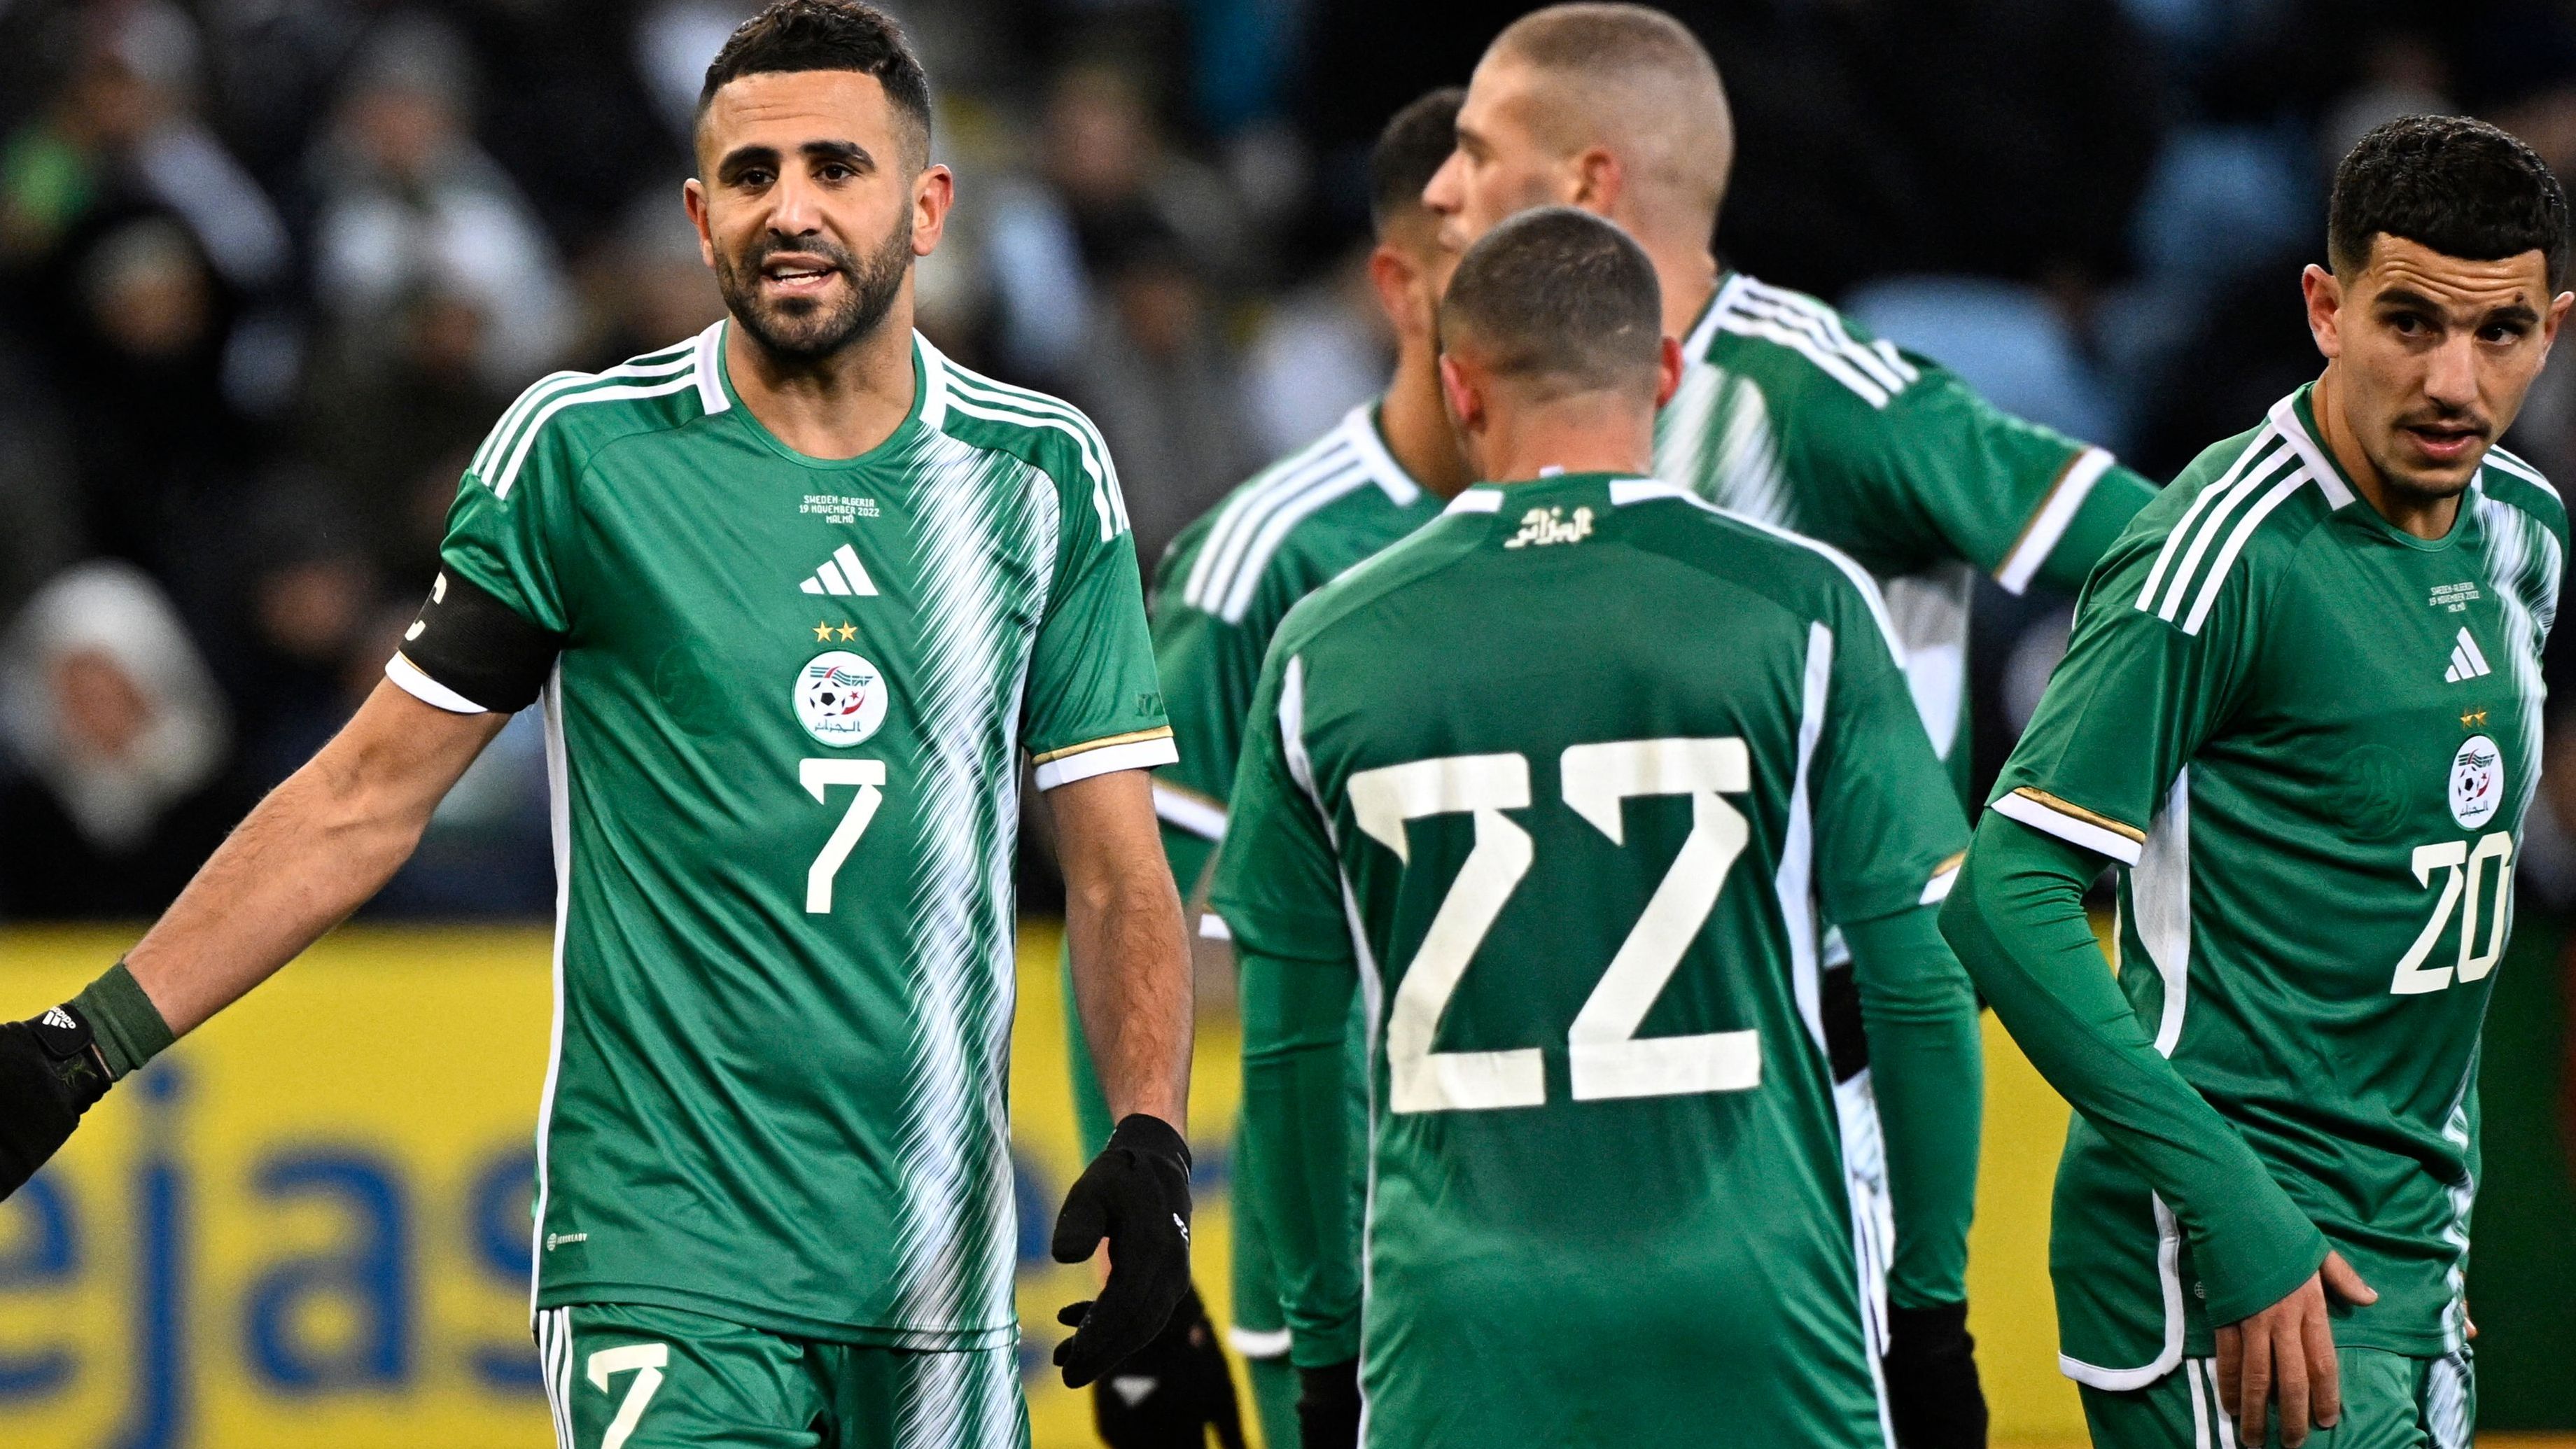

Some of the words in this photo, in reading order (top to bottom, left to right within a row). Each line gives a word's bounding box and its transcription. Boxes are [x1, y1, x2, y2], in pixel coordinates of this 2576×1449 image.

[799, 505, 809, 513] 19
[811, 505, 855, 514] NOVEMBER
[858, 507, 880, 517] 2022
[799, 758, 886, 913] 7
[2390, 831, 2513, 995] 20
[1348, 737, 1760, 1113] 22
[587, 1343, 668, 1449] 7
